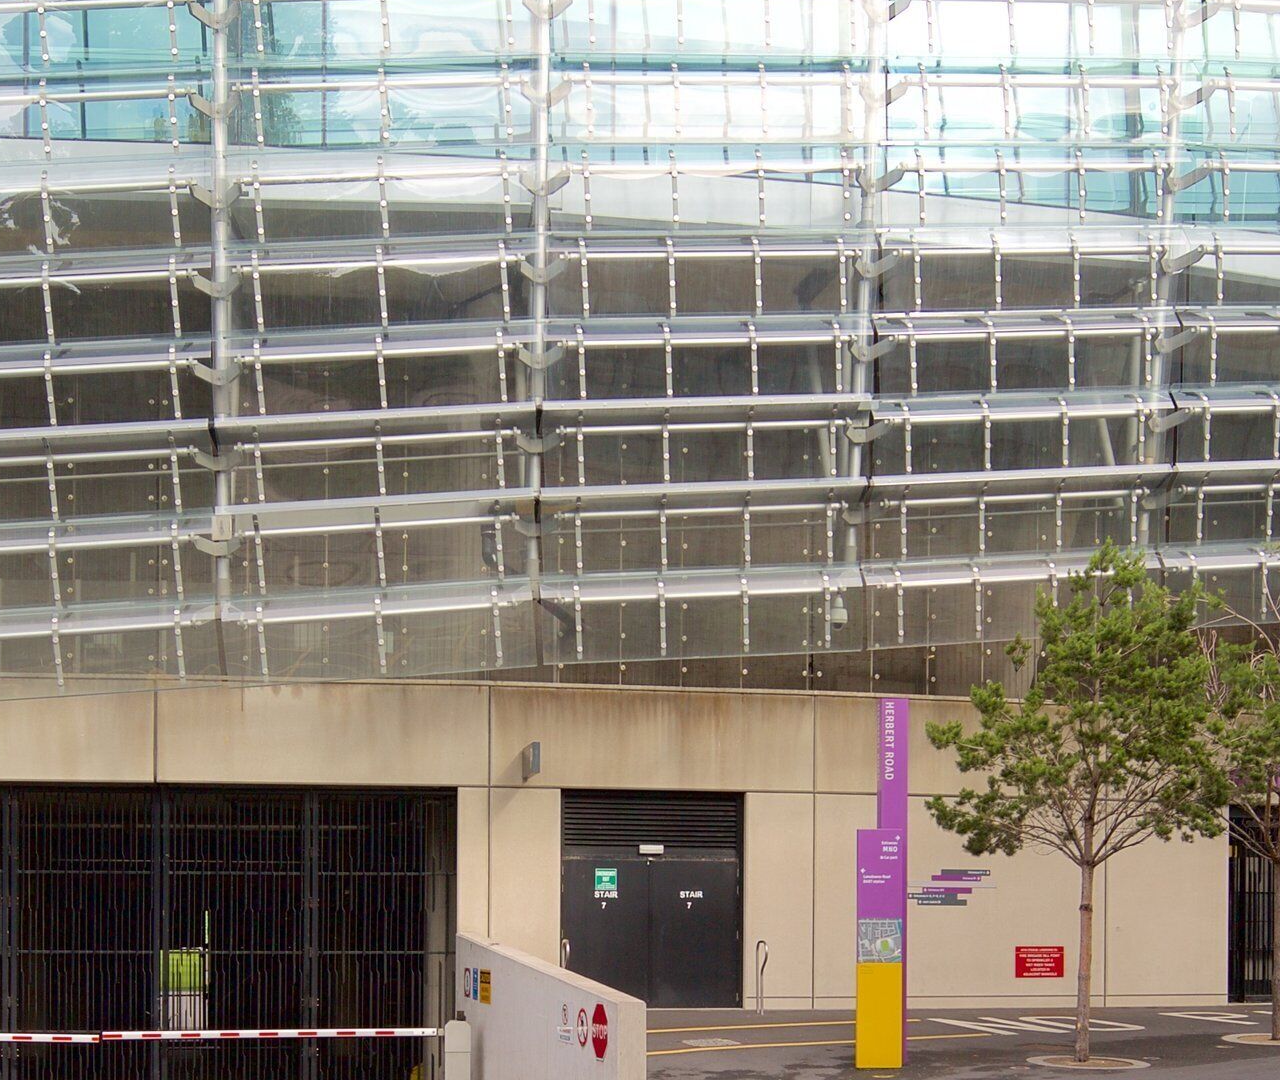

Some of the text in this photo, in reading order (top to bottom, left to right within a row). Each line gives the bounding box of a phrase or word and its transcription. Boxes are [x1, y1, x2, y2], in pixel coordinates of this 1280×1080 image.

[885, 702, 894, 780] HERBERT ROAD
[594, 891, 618, 899] STAIR
[680, 891, 703, 899] STAIR
[927, 1016, 1145, 1035] NO
